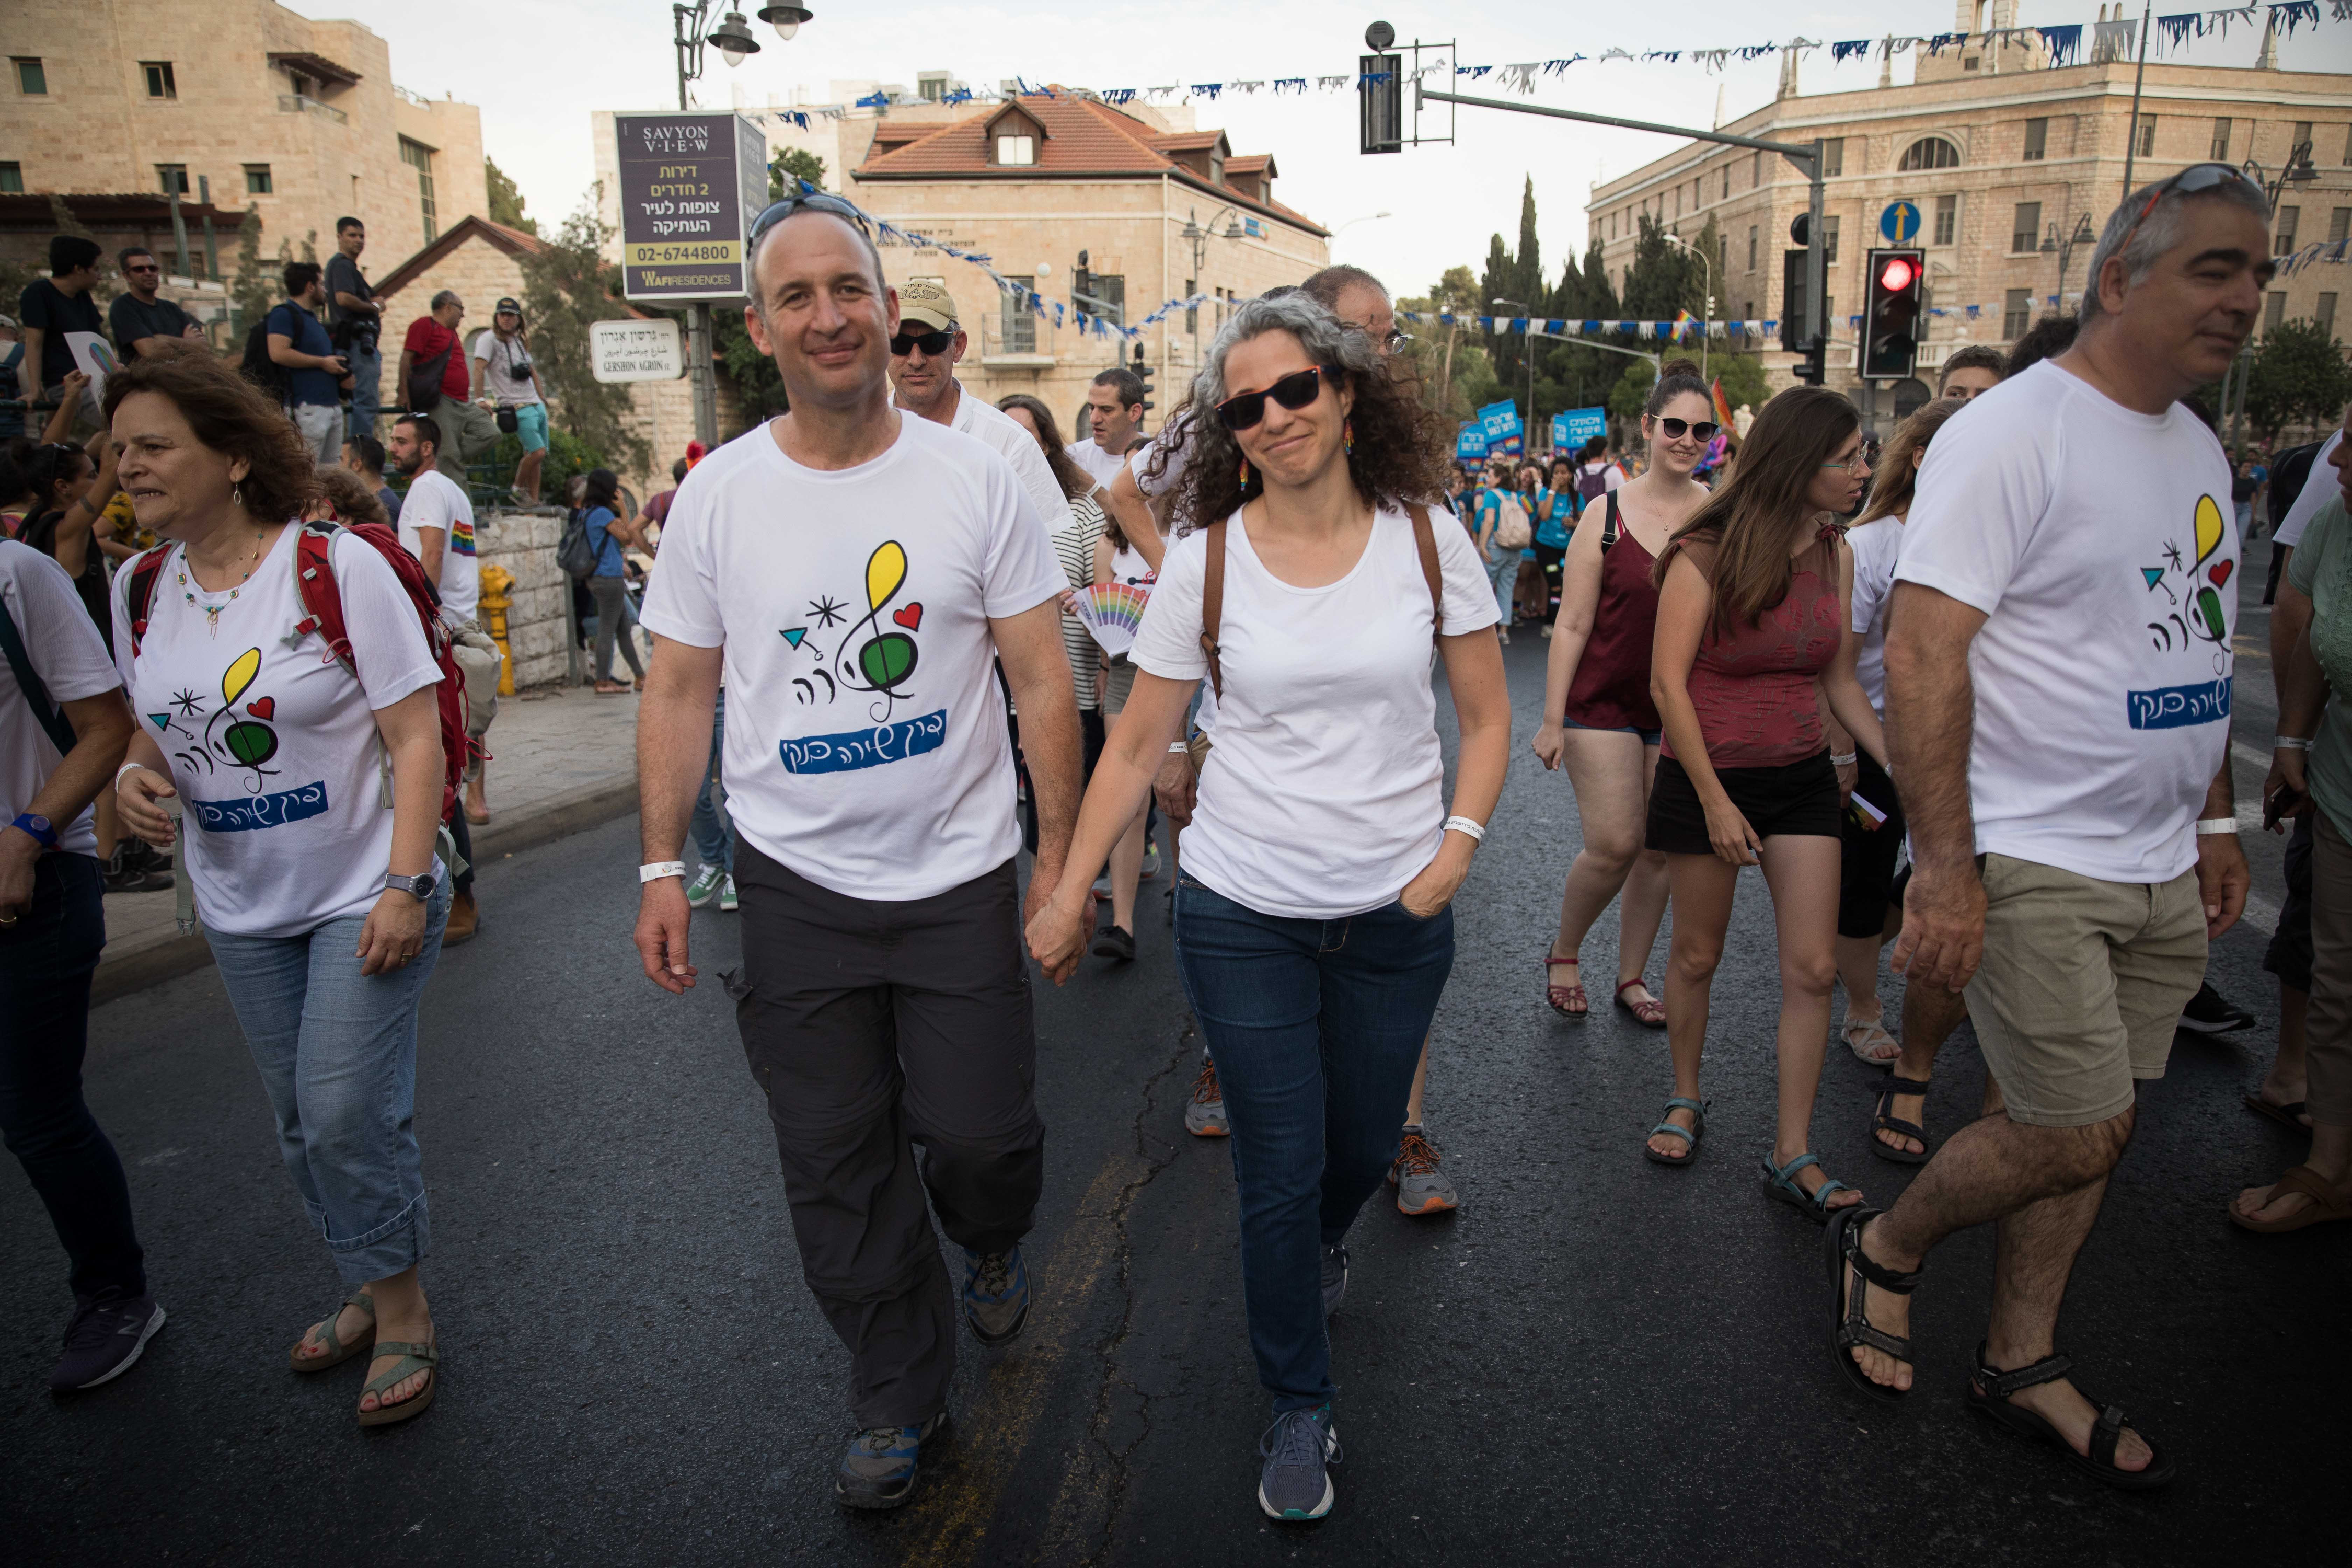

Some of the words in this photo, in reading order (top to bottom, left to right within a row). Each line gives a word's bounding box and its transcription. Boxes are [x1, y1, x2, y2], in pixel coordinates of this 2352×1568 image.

[643, 126, 709, 140] SAVYON
[659, 165, 698, 178] דירות
[650, 184, 696, 197] חדרים
[700, 183, 709, 195] 2
[641, 200, 675, 215] לעיר
[678, 201, 720, 215] צופות
[653, 219, 711, 236] העתיקה
[637, 246, 729, 261] 02-6744800
[603, 361, 636, 373] GERSHON
[639, 360, 663, 371] AGRON
[140, 554, 164, 567] OSPREY
[2190, 679, 2227, 717] שירה
[2134, 693, 2185, 730] בנקי
[837, 725, 894, 764] שירה
[783, 741, 832, 774] בנקי
[227, 795, 273, 825] שירה
[1450, 821, 1471, 829] בירושלים
